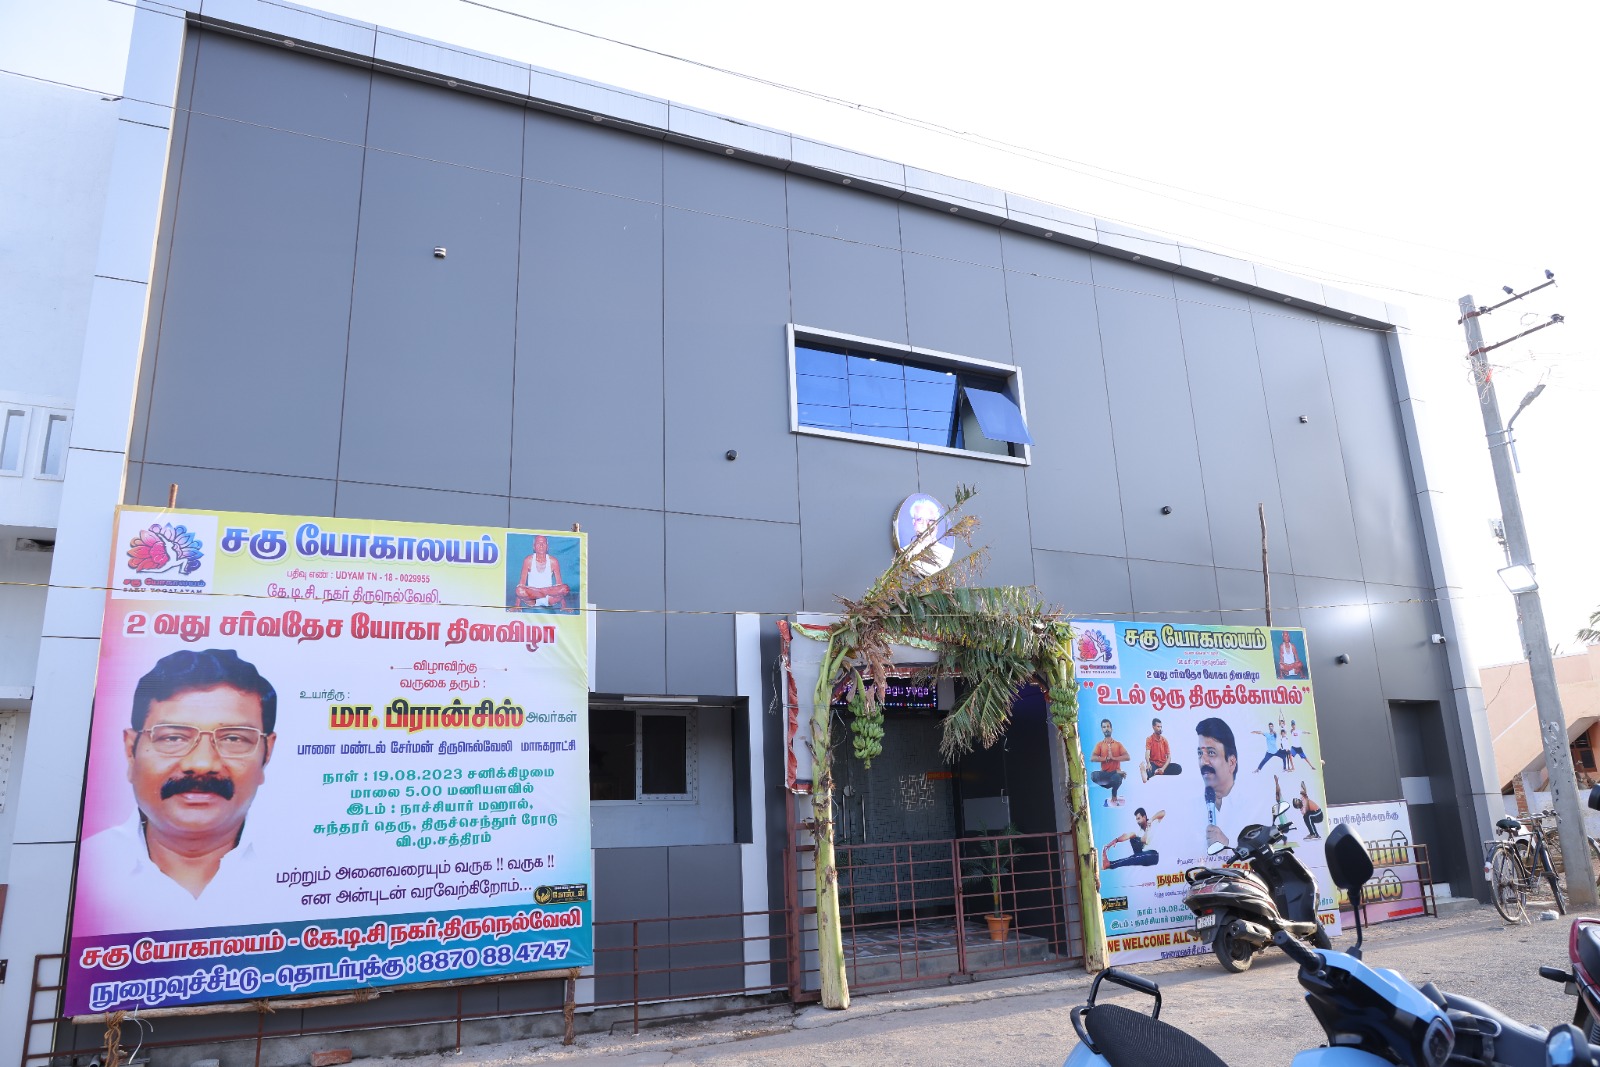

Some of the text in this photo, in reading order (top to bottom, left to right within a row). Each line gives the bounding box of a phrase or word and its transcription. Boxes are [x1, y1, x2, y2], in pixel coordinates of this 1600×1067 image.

[221, 523, 498, 564] சகு யோகாலயம்
[286, 568, 307, 581] பதிவு
[336, 570, 365, 581] UDYAM
[367, 572, 378, 581] TN
[384, 573, 393, 582] 18
[399, 574, 431, 584] 0029955
[321, 585, 350, 605] நகர்
[126, 609, 556, 652] 2 வது சர்வதேச யோகா தினவிழா
[1125, 624, 1267, 651] சகு யோகாலயம்
[413, 660, 477, 675] விழாவிற்கு
[400, 677, 446, 692] வருகை
[448, 677, 480, 692] தரும்
[299, 688, 345, 702] உயர்திரு
[1149, 685, 1186, 712] ஒரு
[385, 697, 525, 732] பிரான்சிஸ்
[526, 710, 577, 724] அவர்கள்
[297, 738, 577, 756] பாளை மண்டல் சேர்மன் திருநெல்வேலி மாநகராட்சி
[322, 769, 359, 786] நாள்
[373, 768, 463, 782] 19.08.2023
[467, 766, 555, 782] சனிக்கிழமை
[350, 782, 534, 799] மாலை 5.00 மணியளவில்
[346, 802, 386, 815] இடம்
[400, 799, 474, 817] நாச்சியார்
[313, 819, 370, 836] சுந்தரர்
[421, 813, 517, 833] திருச்செந்தூர்
[521, 813, 558, 827] ரோடு
[276, 865, 331, 888] மற்றும்
[335, 859, 451, 880] அனைவரையும்
[454, 859, 493, 875] வருக
[507, 855, 544, 873] வருக
[1156, 872, 1185, 888] நடிகர்
[300, 891, 332, 906] என
[336, 885, 406, 905] அன்புடன்
[82, 948, 131, 969] சகு
[134, 929, 285, 961] யோகாலயம்
[1122, 933, 1171, 951] WELCOME
[1173, 931, 1189, 945] ALL
[92, 967, 259, 1009] நுழைவுச்சீட்டு
[419, 949, 478, 970] 8870
[482, 946, 512, 965] 88
[516, 940, 570, 961] 4747
